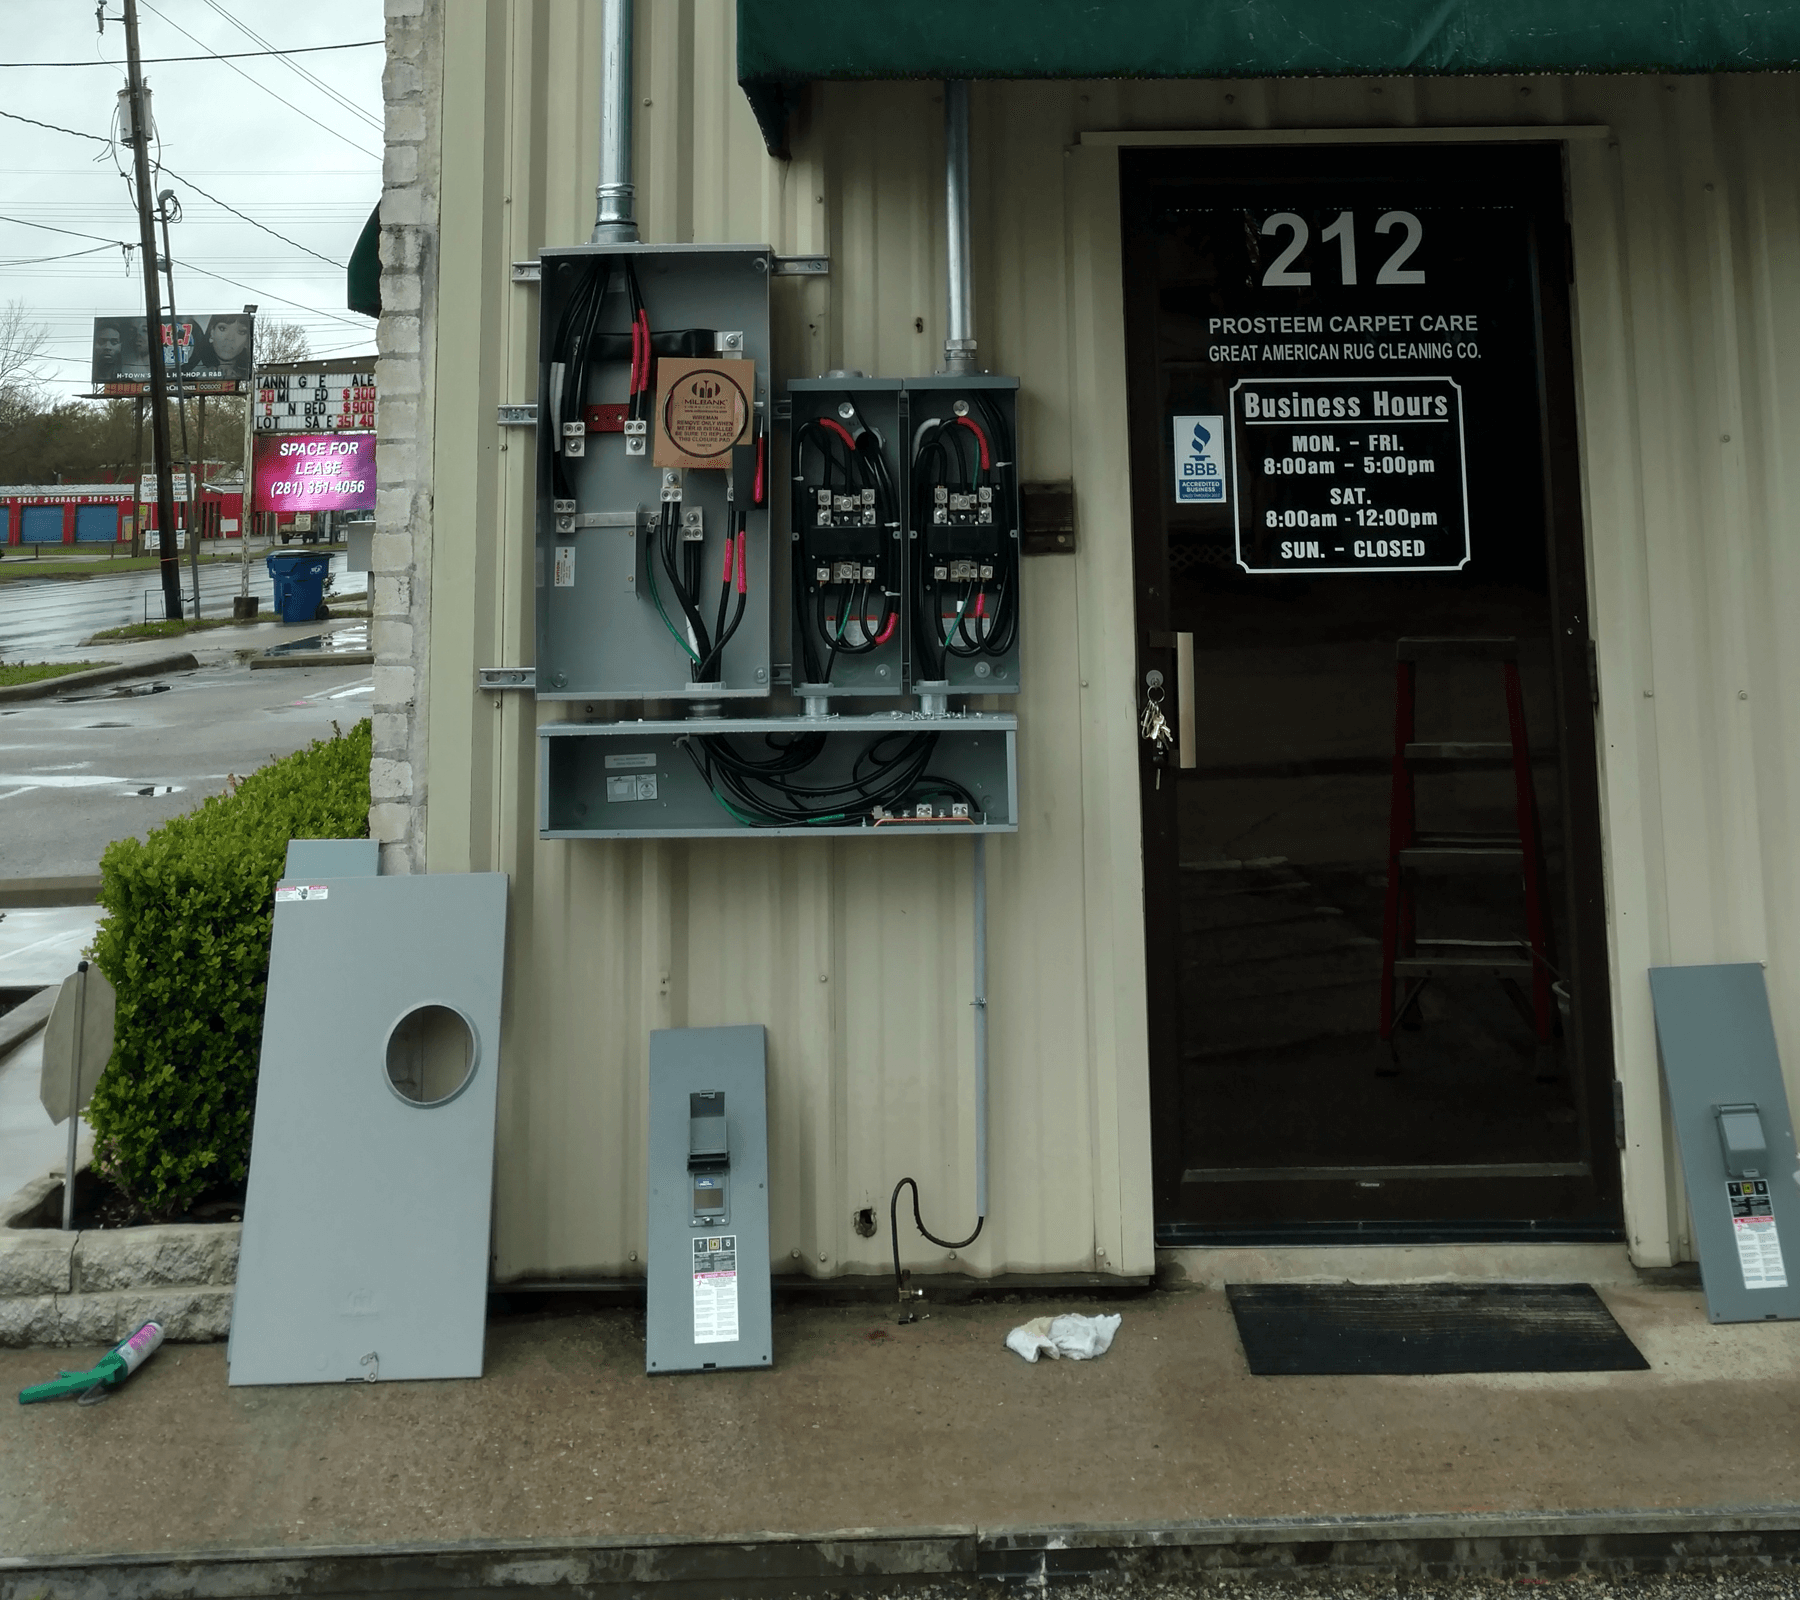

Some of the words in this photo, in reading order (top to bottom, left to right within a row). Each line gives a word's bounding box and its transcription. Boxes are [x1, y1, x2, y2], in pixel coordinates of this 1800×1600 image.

[1261, 210, 1425, 286] 212
[1209, 316, 1323, 334] PROSTEEM
[1329, 315, 1414, 333] CARPET
[1420, 315, 1478, 331] CARE
[1209, 344, 1258, 362] GREAT
[1262, 343, 1340, 361] AMERICAN
[1344, 343, 1375, 360] RUG
[1379, 342, 1453, 360] CLEANING
[1457, 342, 1482, 359] CO.
[304, 402, 326, 415] BED
[1244, 391, 1361, 418] Business
[1373, 390, 1448, 417] Hours
[256, 416, 280, 429] LOT
[279, 442, 327, 456] SPACE
[329, 441, 359, 455] FOR
[1292, 435, 1341, 452] MON.
[1368, 434, 1404, 451] FRI.
[295, 461, 343, 475] LEASE
[1183, 462, 1218, 476] BBB
[1264, 457, 1335, 475] 8:00am
[1363, 456, 1435, 476] 5:00pm
[270, 481, 304, 498] (281)
[307, 480, 365, 495] 351-4056
[1330, 487, 1372, 505] SAT.
[1266, 510, 1337, 527] 8:00am
[1356, 508, 1438, 528] 12:00pm
[1281, 541, 1326, 559] SUN.
[1354, 539, 1426, 558] CLOSED
